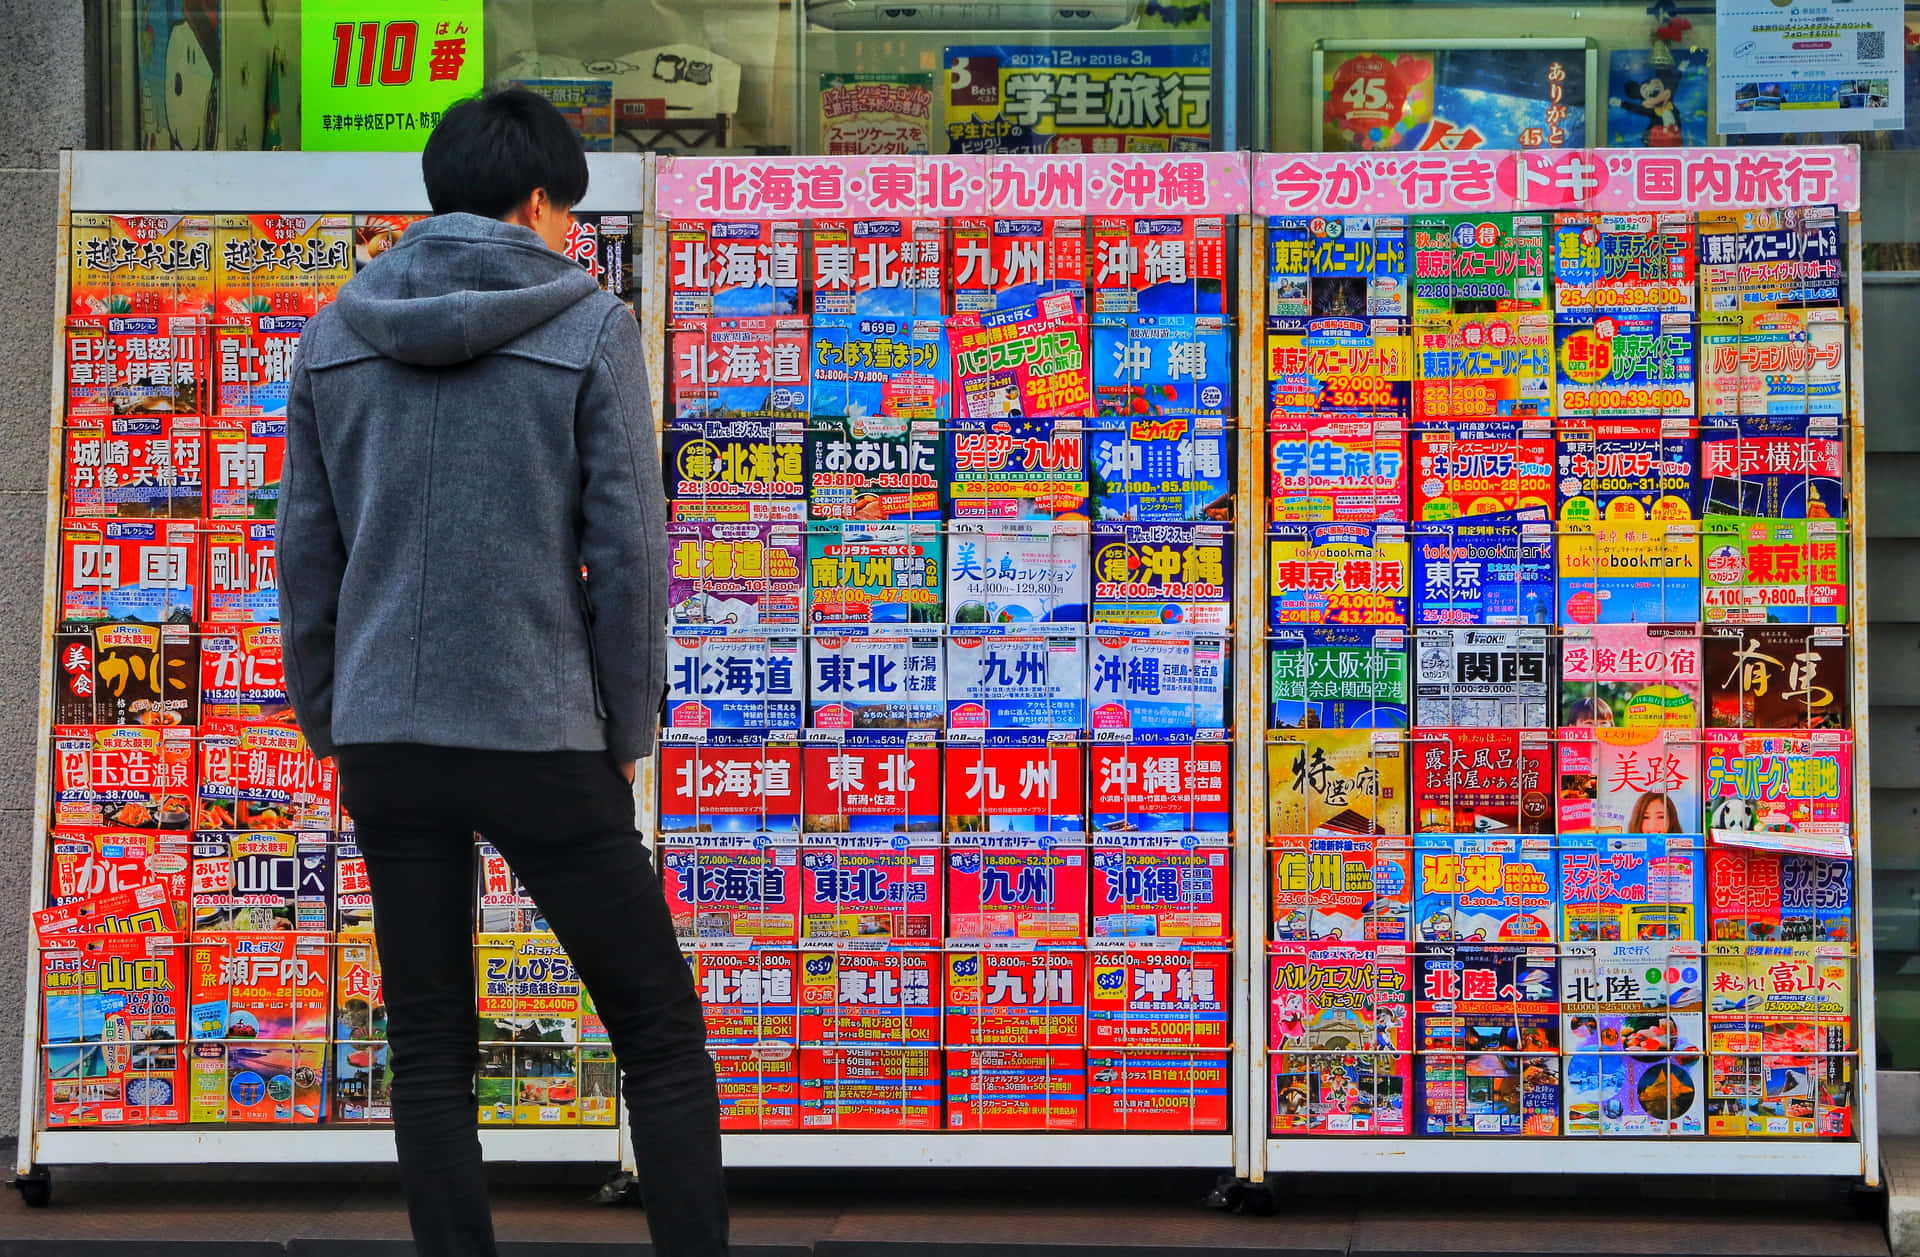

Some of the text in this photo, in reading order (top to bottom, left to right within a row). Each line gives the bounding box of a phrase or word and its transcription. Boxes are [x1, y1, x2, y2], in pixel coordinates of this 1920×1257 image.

[436, 21, 469, 35] ばん
[971, 85, 997, 96] Best
[1006, 73, 1210, 128] 学生旅行
[1547, 62, 1567, 145] ありがと
[830, 127, 922, 142] スーツケースを
[949, 122, 1022, 140] 学生だけの
[1519, 128, 1542, 146] 45
[700, 158, 1208, 214] 北海道・東北・九州・沖縄
[127, 218, 168, 231] 年末年始
[136, 229, 157, 239] 特集
[265, 218, 305, 231] 年末年始
[275, 228, 296, 239] 特集
[1743, 211, 1797, 231] 2018
[86, 238, 210, 271] 越年お正月
[224, 238, 349, 271] 越年お正月
[900, 241, 939, 263] 新潟
[1097, 240, 1187, 284] 沖縄
[1274, 240, 1398, 275] 東京ディズニーリゾート
[1602, 235, 1687, 259] 東京ディズニー
[1707, 231, 1829, 265] 東京ディズニーリゾート
[674, 242, 799, 289] 北海道
[815, 243, 899, 290] 東北
[956, 240, 1045, 285] 九州
[1416, 250, 1537, 278] 東京ディズニーリゾート
[901, 267, 940, 289] 佐渡
[860, 321, 897, 335] 第69回
[988, 309, 1033, 326] JRで行く
[71, 338, 194, 361] 日光・鬼怒川
[815, 338, 939, 369] さっぽろ雪まつり
[959, 331, 1081, 375] ハウステンボス
[1112, 341, 1208, 380] 沖縄
[1611, 334, 1691, 358] 東京ディズニー
[1714, 344, 1841, 372] バケーションパッケージ
[71, 363, 195, 385] 草津・伊香保
[680, 344, 802, 384] 北海道
[1272, 348, 1389, 376] 東京ディズニーリゾート
[1423, 351, 1543, 378] 東京ディズニーリゾート
[73, 439, 201, 467] 城崎・湯村
[722, 442, 803, 483] 北海道
[825, 442, 936, 471] おおいた
[1024, 438, 1079, 469] 九州
[1275, 442, 1402, 479] 学生旅行
[1710, 442, 1818, 473] 東京・横浜
[73, 466, 202, 488] 丹後・天橋立
[1614, 502, 1635, 513] 宿泊
[73, 545, 187, 590] 四国
[674, 541, 764, 579] 北海道
[811, 557, 892, 587] 南九州
[1141, 545, 1224, 586] 沖縄
[1425, 562, 1482, 588] 東京
[1747, 545, 1800, 584] 東京
[1278, 560, 1403, 592] 東京・横浜
[103, 634, 153, 645] 味覚太鼓判
[112, 626, 142, 634] JRで行く
[98, 652, 187, 697] かに
[674, 656, 793, 695] 北海道
[817, 654, 897, 693] 東北
[979, 652, 1045, 687] 九州
[1094, 654, 1161, 695] 沖縄
[1275, 652, 1402, 679] 京都・大阪・神戸
[1457, 652, 1544, 683] 関西
[1564, 648, 1696, 675] 受験生の宿
[1275, 680, 1403, 698] 滋賀・奈良・関西空港
[103, 738, 153, 749] 味覚太鼓判
[112, 730, 142, 738] JRで行く
[247, 737, 298, 749] 味覚太鼓判
[92, 751, 189, 788] 玉造温泉
[827, 754, 916, 793] 東北
[1425, 748, 1539, 770] 露天風呂付の
[676, 759, 791, 798] 北海道
[965, 760, 1058, 800] 九州
[1100, 757, 1181, 795] 沖縄
[1425, 771, 1539, 790] お部屋がある宿
[102, 834, 148, 846] 味覚太鼓判
[238, 842, 289, 853] 味覚太鼓判
[247, 834, 279, 843] JRで行く
[678, 867, 785, 904] 北海道
[815, 869, 888, 904] 東北
[981, 867, 1055, 904] 九州
[1107, 867, 1179, 904] 沖縄
[1278, 853, 1342, 892] 信州
[1345, 872, 1370, 881] SNOW
[1345, 881, 1374, 891] BOARD
[1423, 855, 1502, 894] 近郊
[1504, 874, 1543, 883] SNOW
[1504, 883, 1548, 893] BOARD
[1716, 888, 1779, 908] サーキット
[1784, 888, 1848, 908] スパーランド
[1613, 946, 1650, 956] JRで行く
[99, 957, 174, 992] 山口へ
[219, 955, 325, 986] 瀬戸内へ
[1133, 968, 1214, 1001] 沖縄
[1275, 964, 1404, 990] パルケエスパーニャ
[1425, 969, 1497, 1000] 北陸
[1769, 962, 1842, 993] 富山へ
[702, 969, 792, 1005] 北海道
[838, 970, 898, 1005] 東北
[987, 968, 1073, 1004] 九州
[1567, 975, 1640, 1003] 北陸
